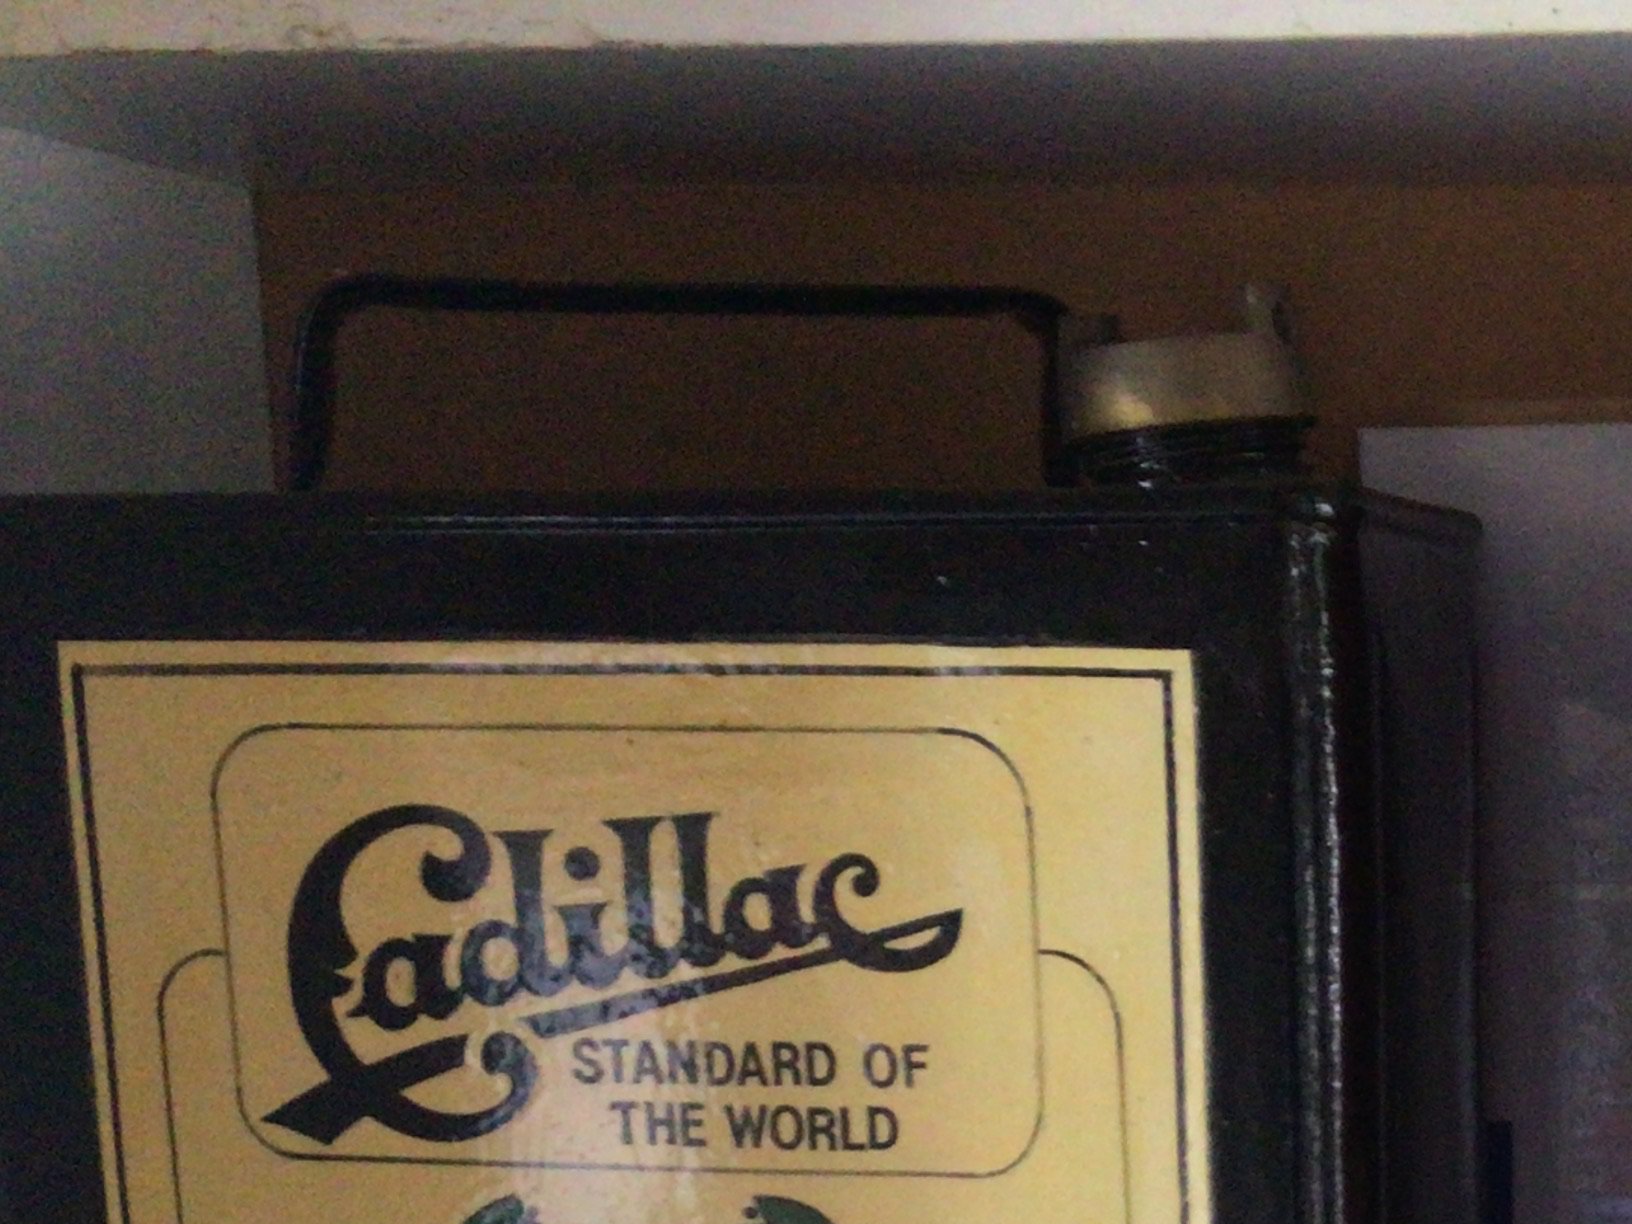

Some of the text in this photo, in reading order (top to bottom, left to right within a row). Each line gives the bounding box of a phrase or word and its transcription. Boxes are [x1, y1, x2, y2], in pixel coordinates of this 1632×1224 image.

[261, 803, 963, 1145] Cadillac
[571, 1038, 930, 1089] STANDARD OF
[609, 1101, 899, 1152] THE WORLD
